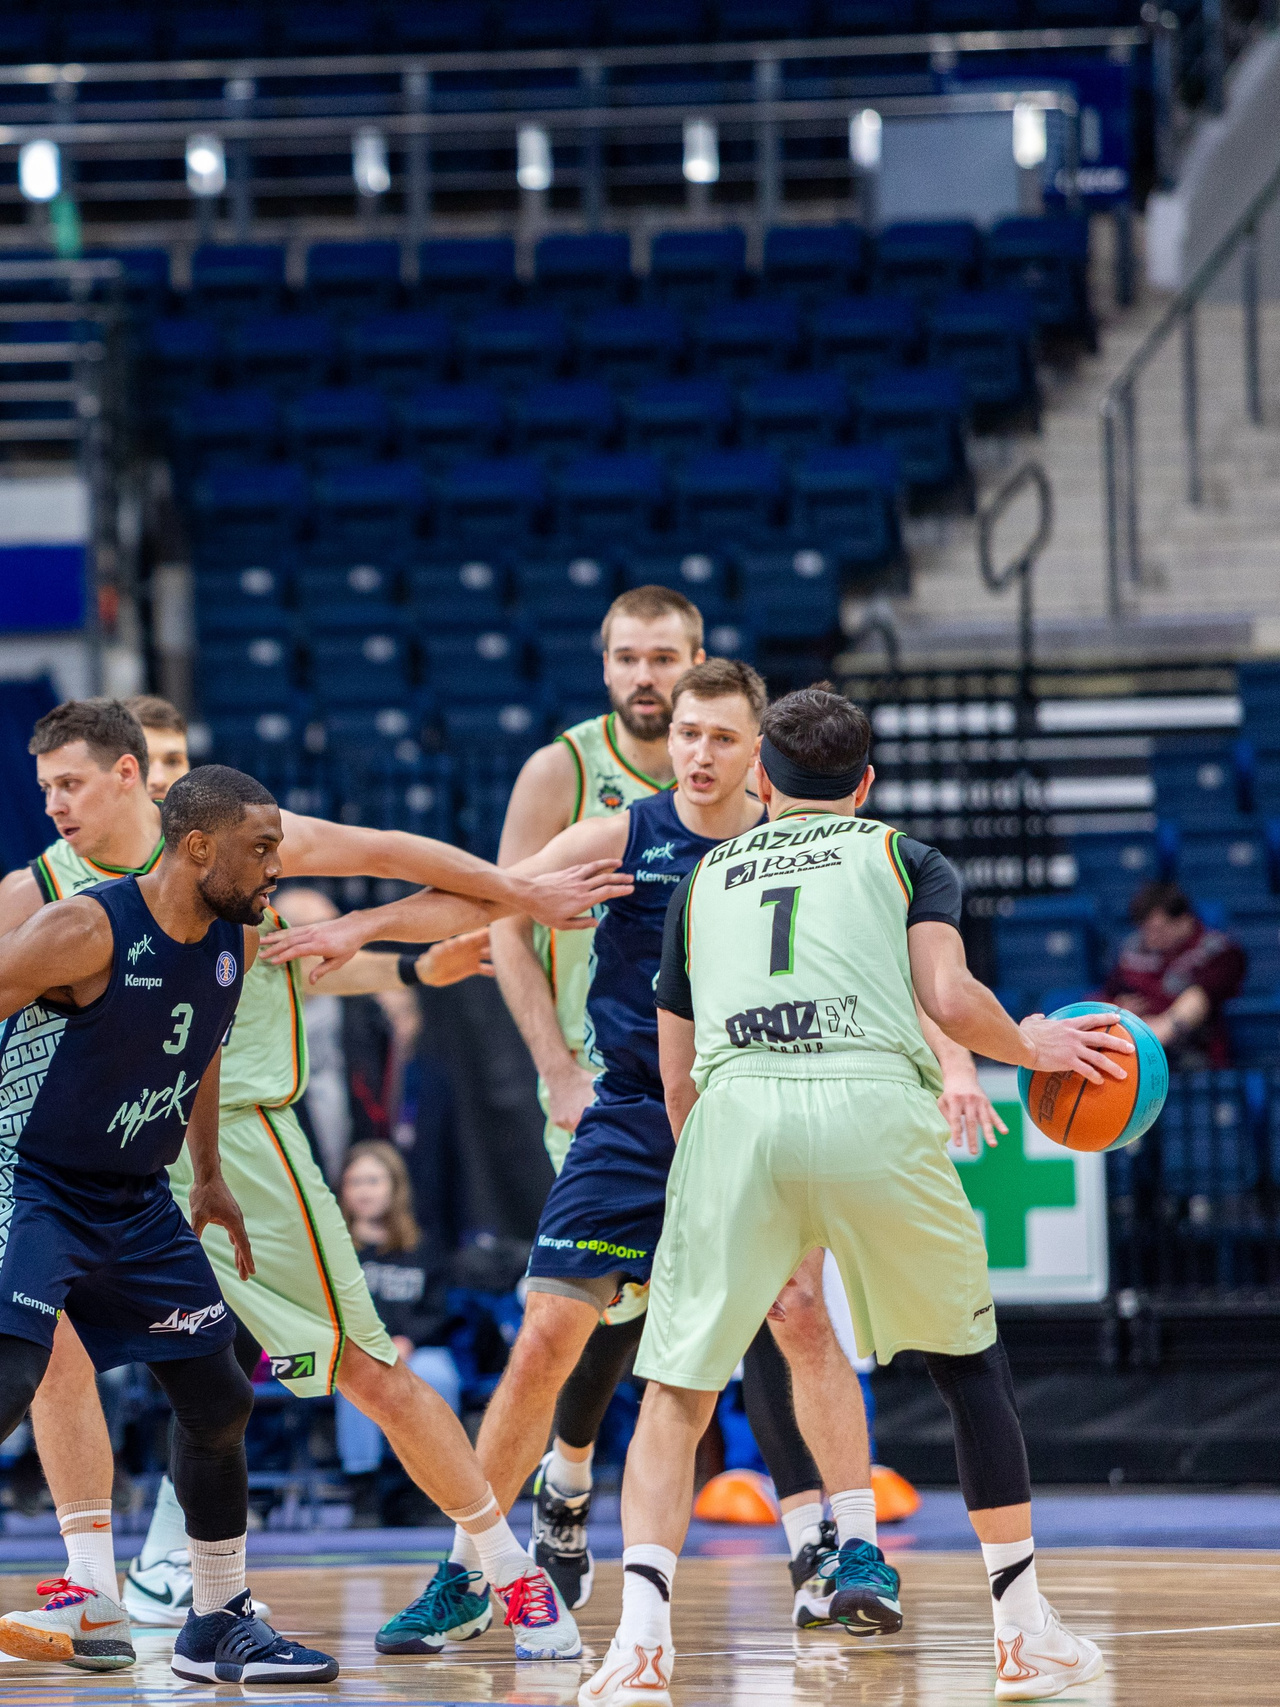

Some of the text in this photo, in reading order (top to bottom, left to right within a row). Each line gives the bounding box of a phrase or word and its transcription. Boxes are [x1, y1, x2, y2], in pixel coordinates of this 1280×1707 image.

[706, 820, 879, 868] GLAZUNOV
[761, 846, 843, 873] Робек
[636, 869, 680, 885] Kempa
[760, 886, 802, 977] 1
[125, 974, 163, 990] Kempa
[162, 1003, 194, 1055] 3
[537, 1235, 574, 1249] Kempa
[12, 1291, 55, 1315] Kempa
